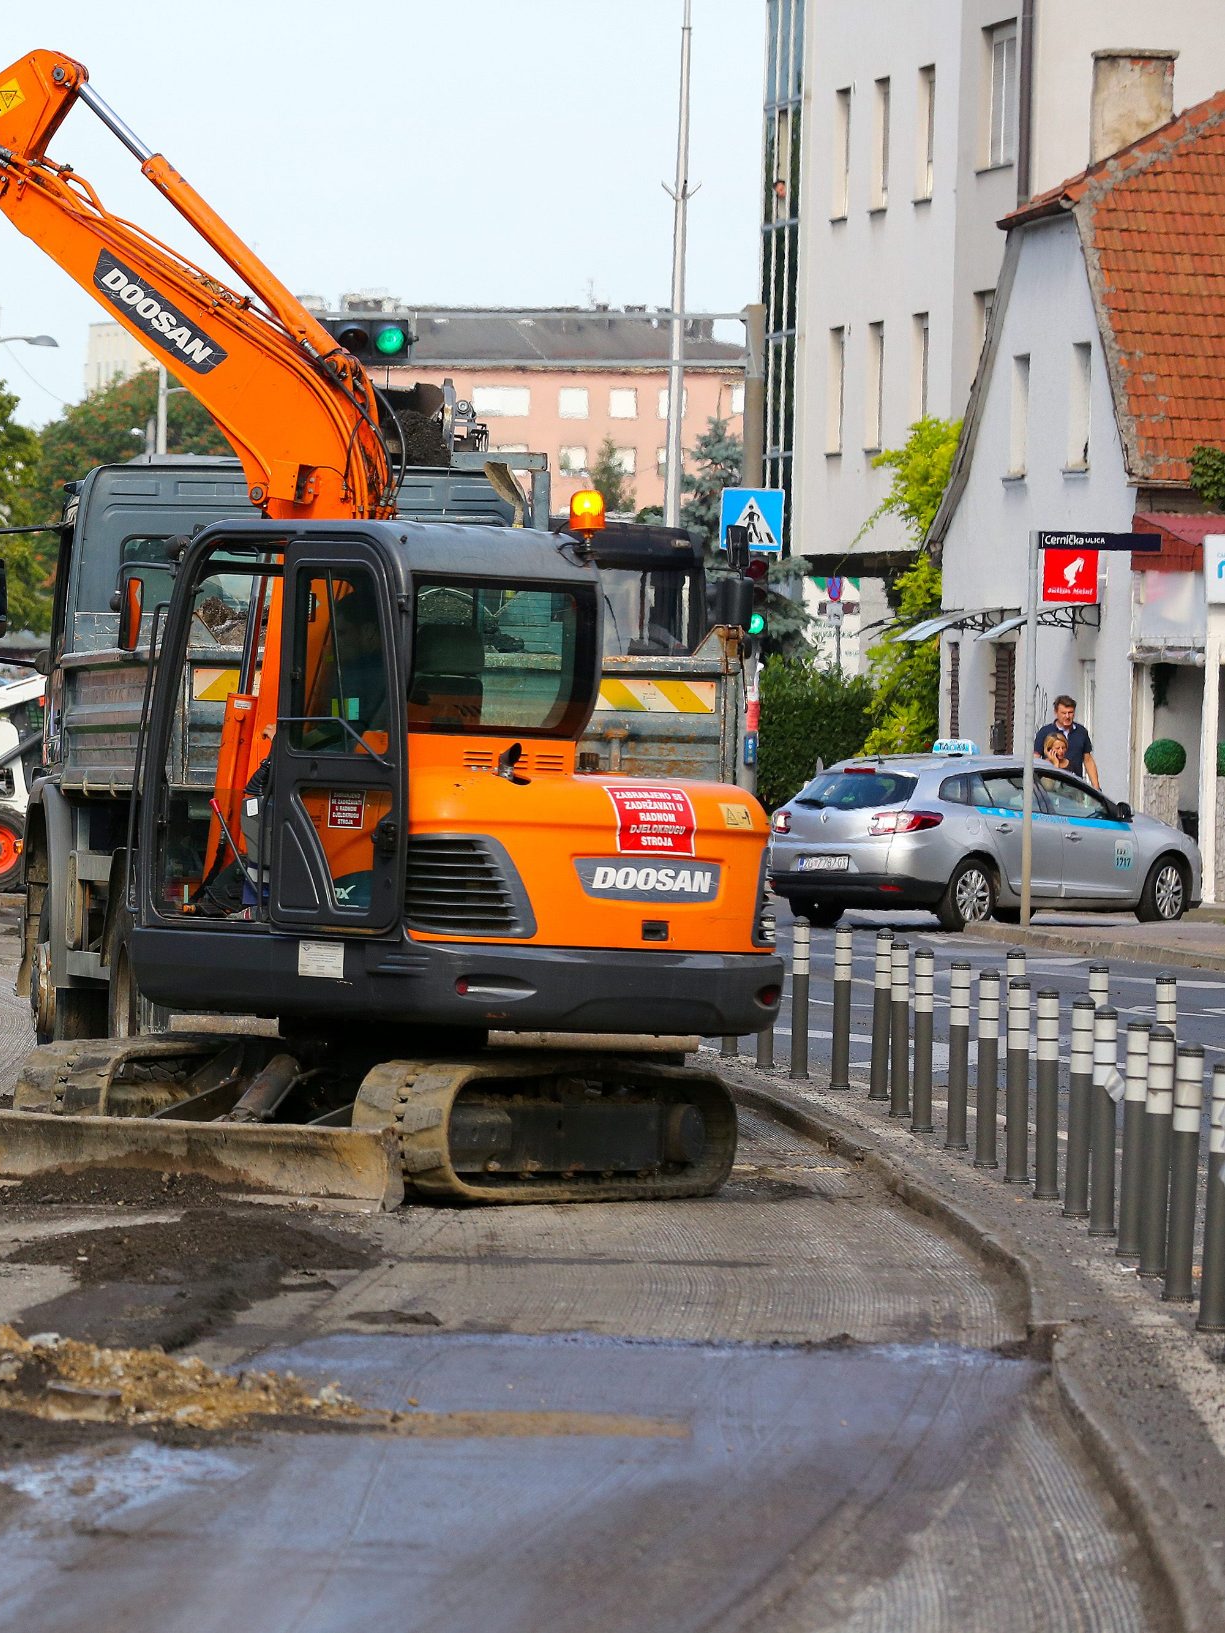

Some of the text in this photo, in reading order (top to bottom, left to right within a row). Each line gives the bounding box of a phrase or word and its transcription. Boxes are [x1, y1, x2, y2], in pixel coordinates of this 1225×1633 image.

[101, 267, 214, 364] DOOSAN
[1044, 534, 1084, 545] Cernička
[613, 791, 685, 802] ZABRANJENO SE
[624, 800, 684, 812] ZADRŽAVATI U
[638, 812, 676, 823] RADNOM
[629, 824, 686, 835] DJELOKRUGU
[640, 836, 674, 847] STROJA
[591, 866, 712, 894] DOOSAN
